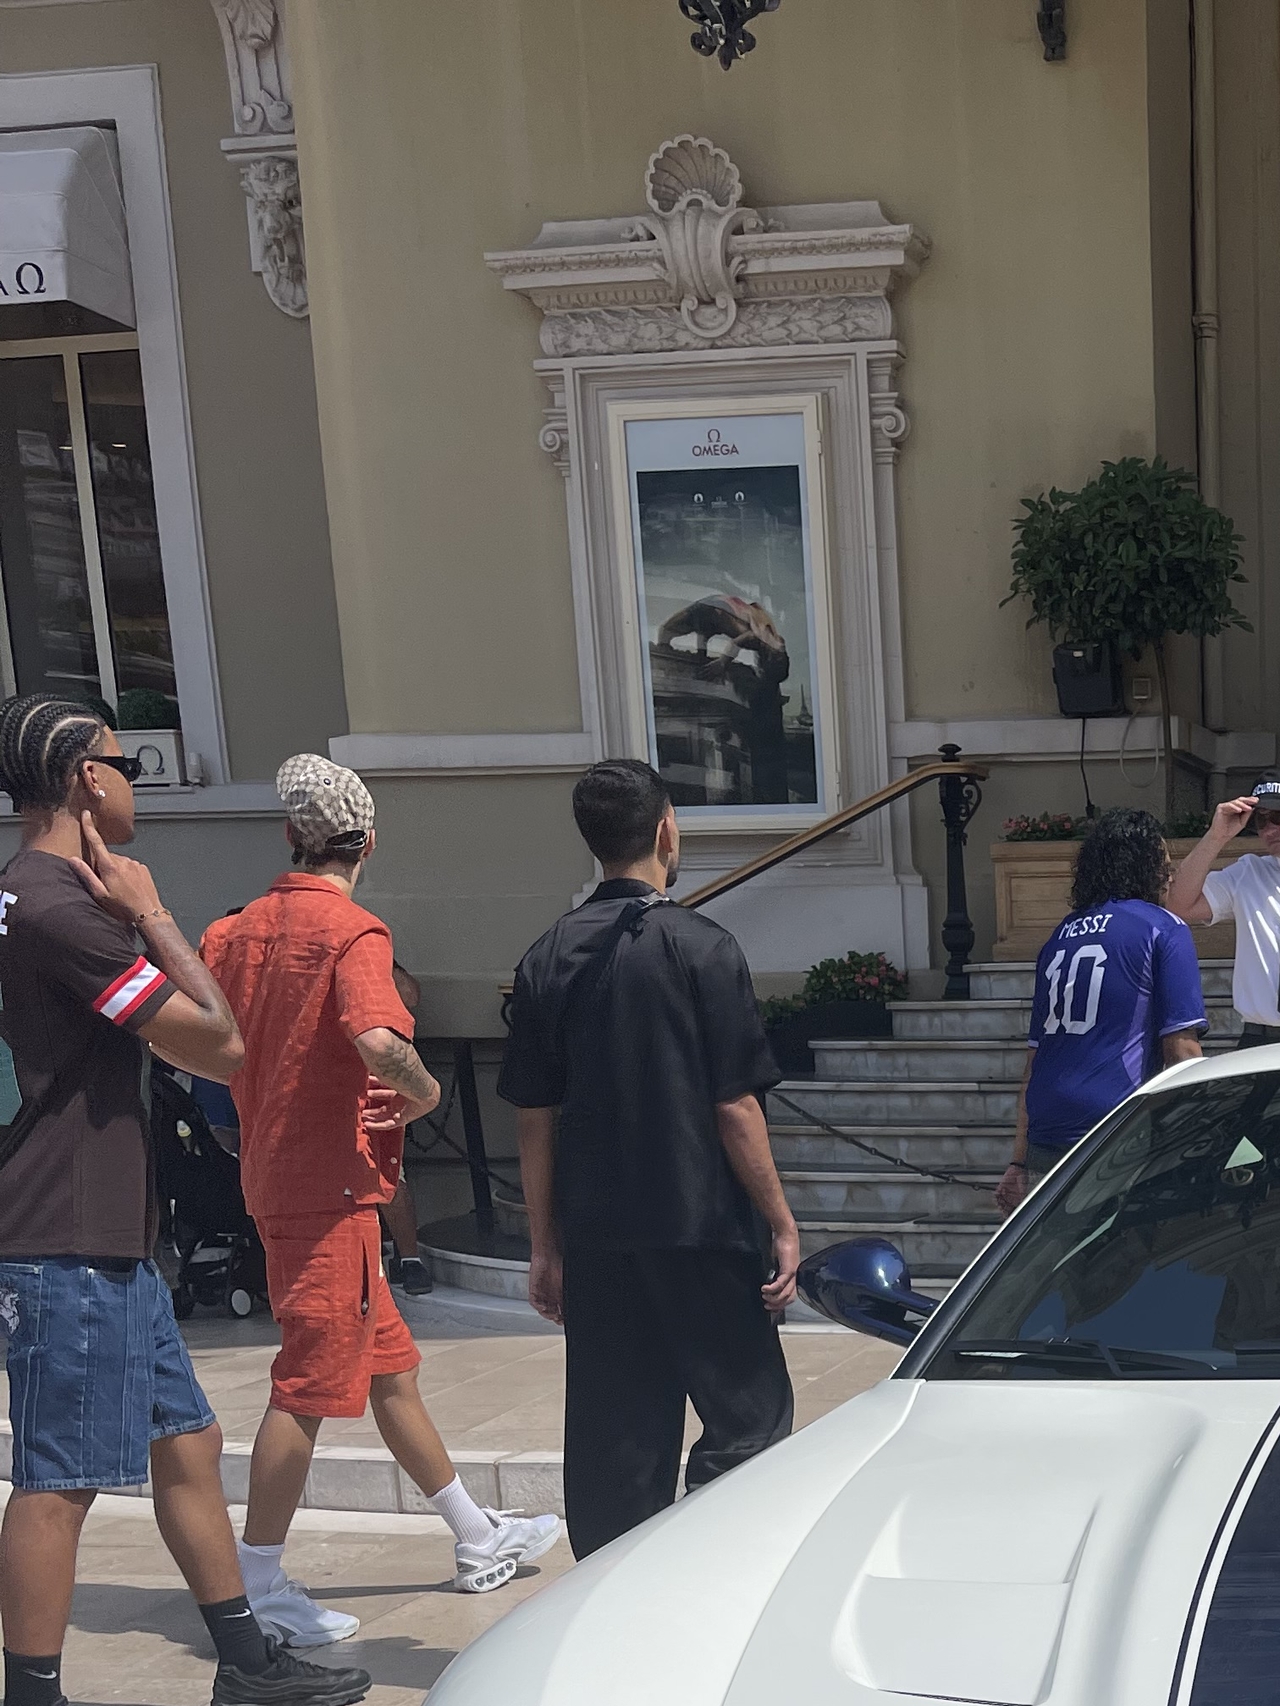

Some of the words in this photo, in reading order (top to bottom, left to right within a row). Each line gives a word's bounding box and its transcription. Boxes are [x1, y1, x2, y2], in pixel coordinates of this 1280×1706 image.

[692, 443, 739, 457] OMEGA
[1058, 914, 1113, 940] MESSI
[1043, 944, 1108, 1035] 10
